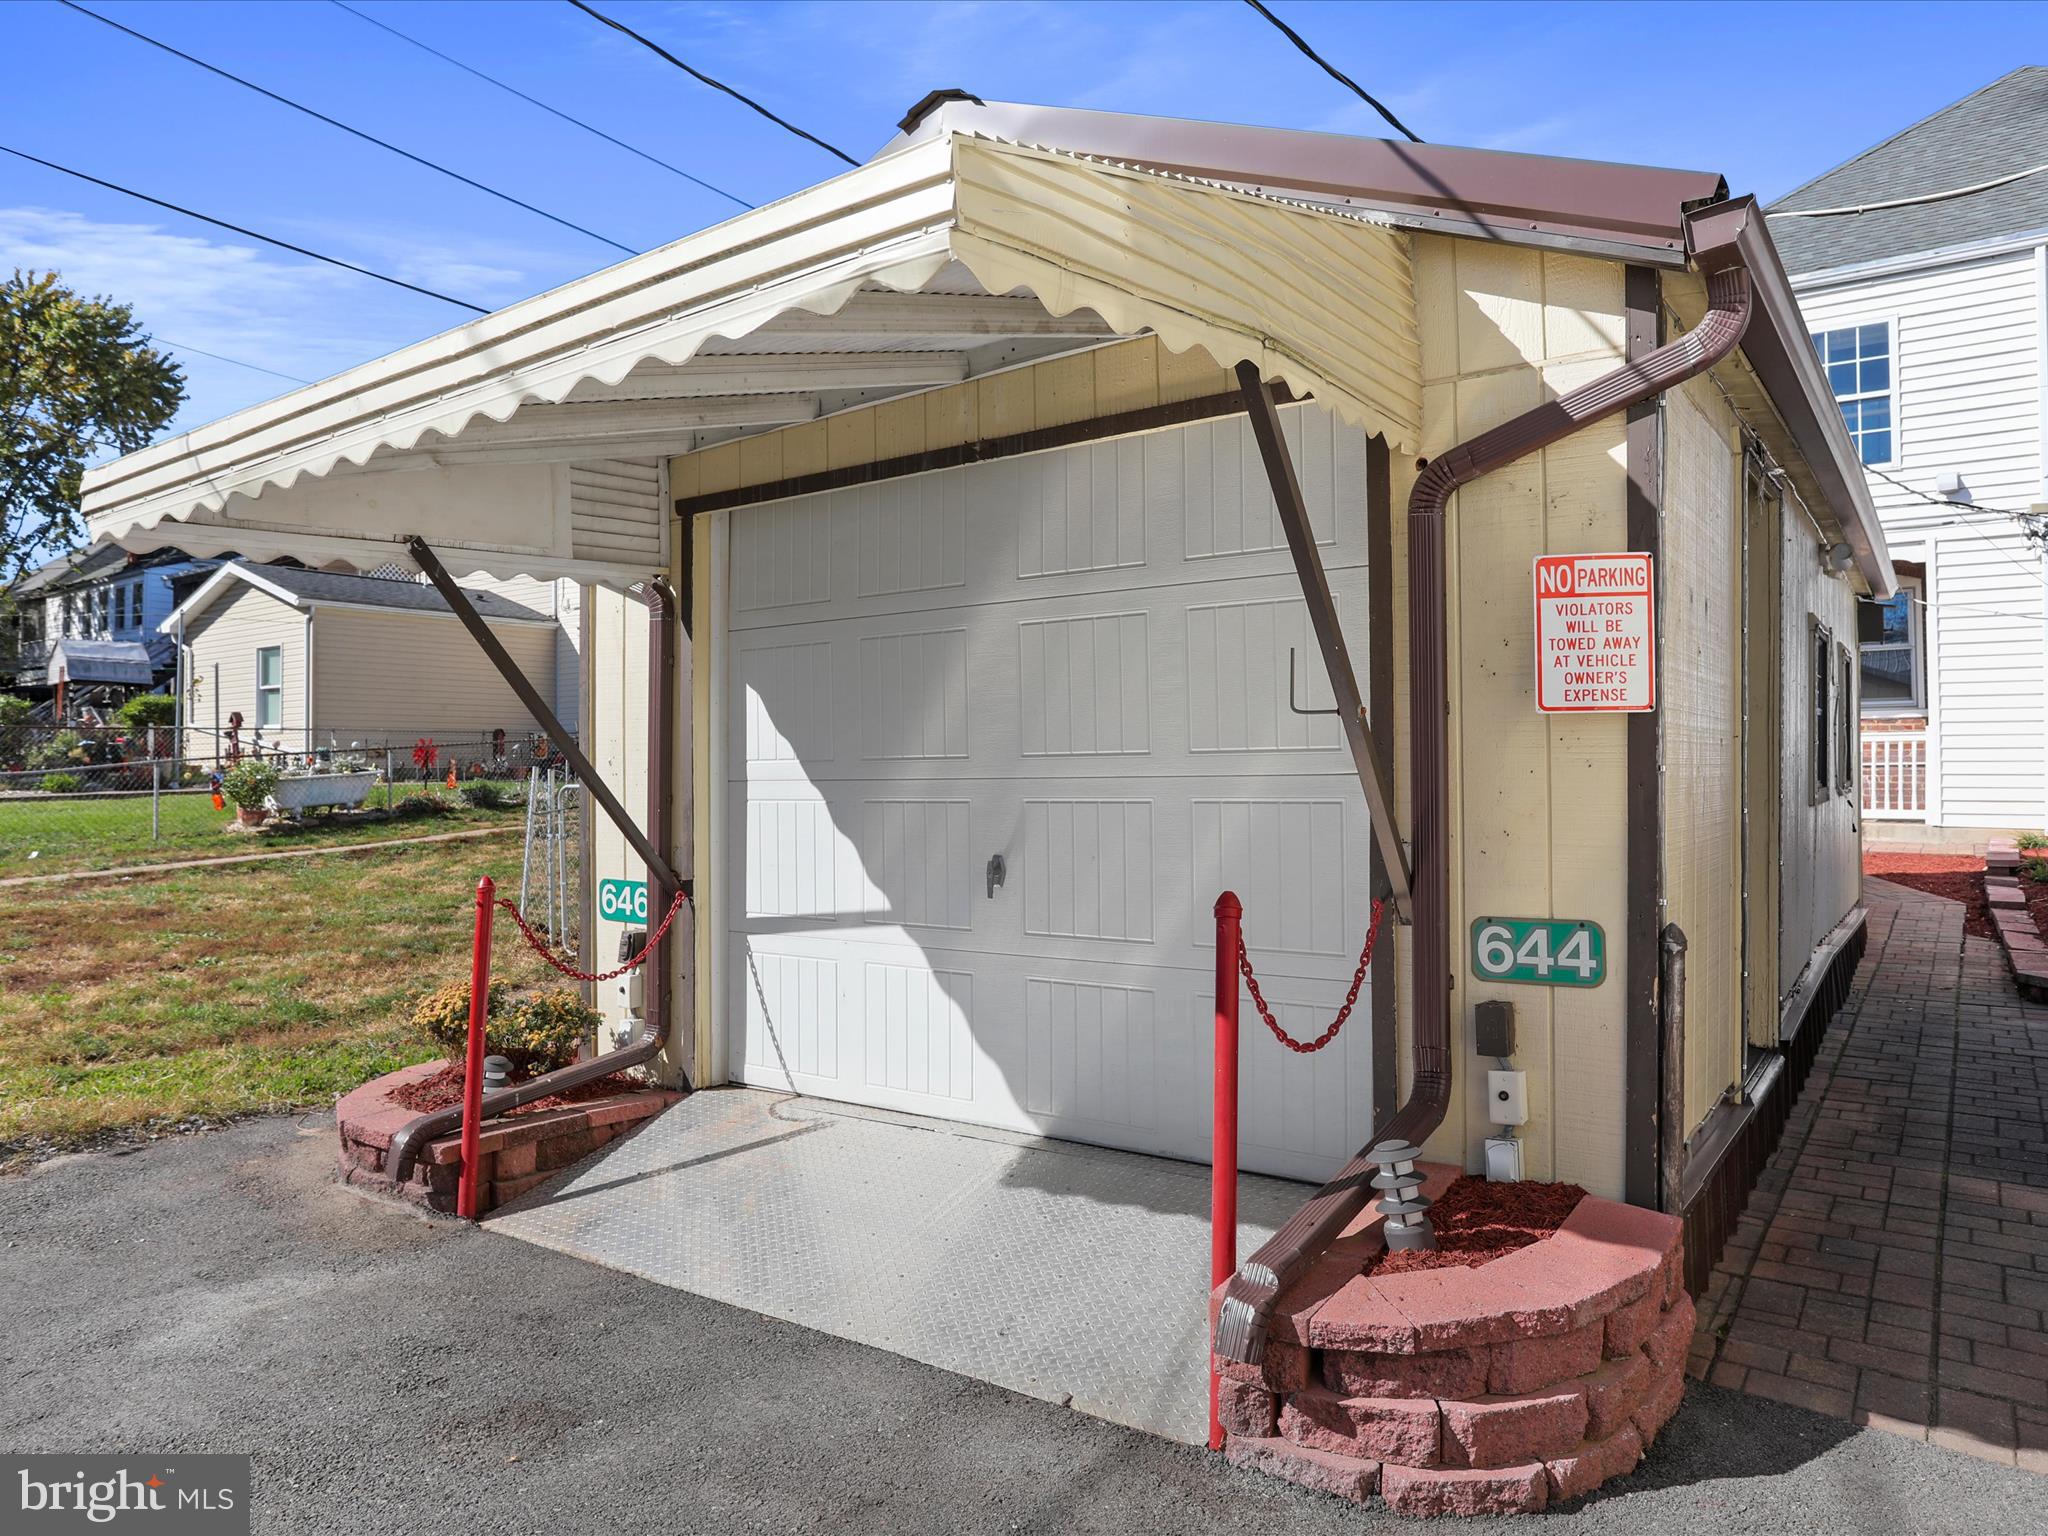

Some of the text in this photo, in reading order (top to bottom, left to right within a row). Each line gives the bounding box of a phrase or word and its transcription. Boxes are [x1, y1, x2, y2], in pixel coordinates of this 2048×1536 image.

[1540, 564, 1645, 593] NO PARKING
[1555, 602, 1633, 616] VIOLATORS
[1566, 619, 1623, 633] WILL BE
[1549, 636, 1641, 651] TOWED AWAY
[1554, 654, 1636, 668] AT VEHICLE
[1564, 671, 1627, 685] OWNER'S
[1564, 688, 1628, 702] EXPENSE
[601, 883, 648, 918] 646
[1477, 925, 1597, 978] 644
